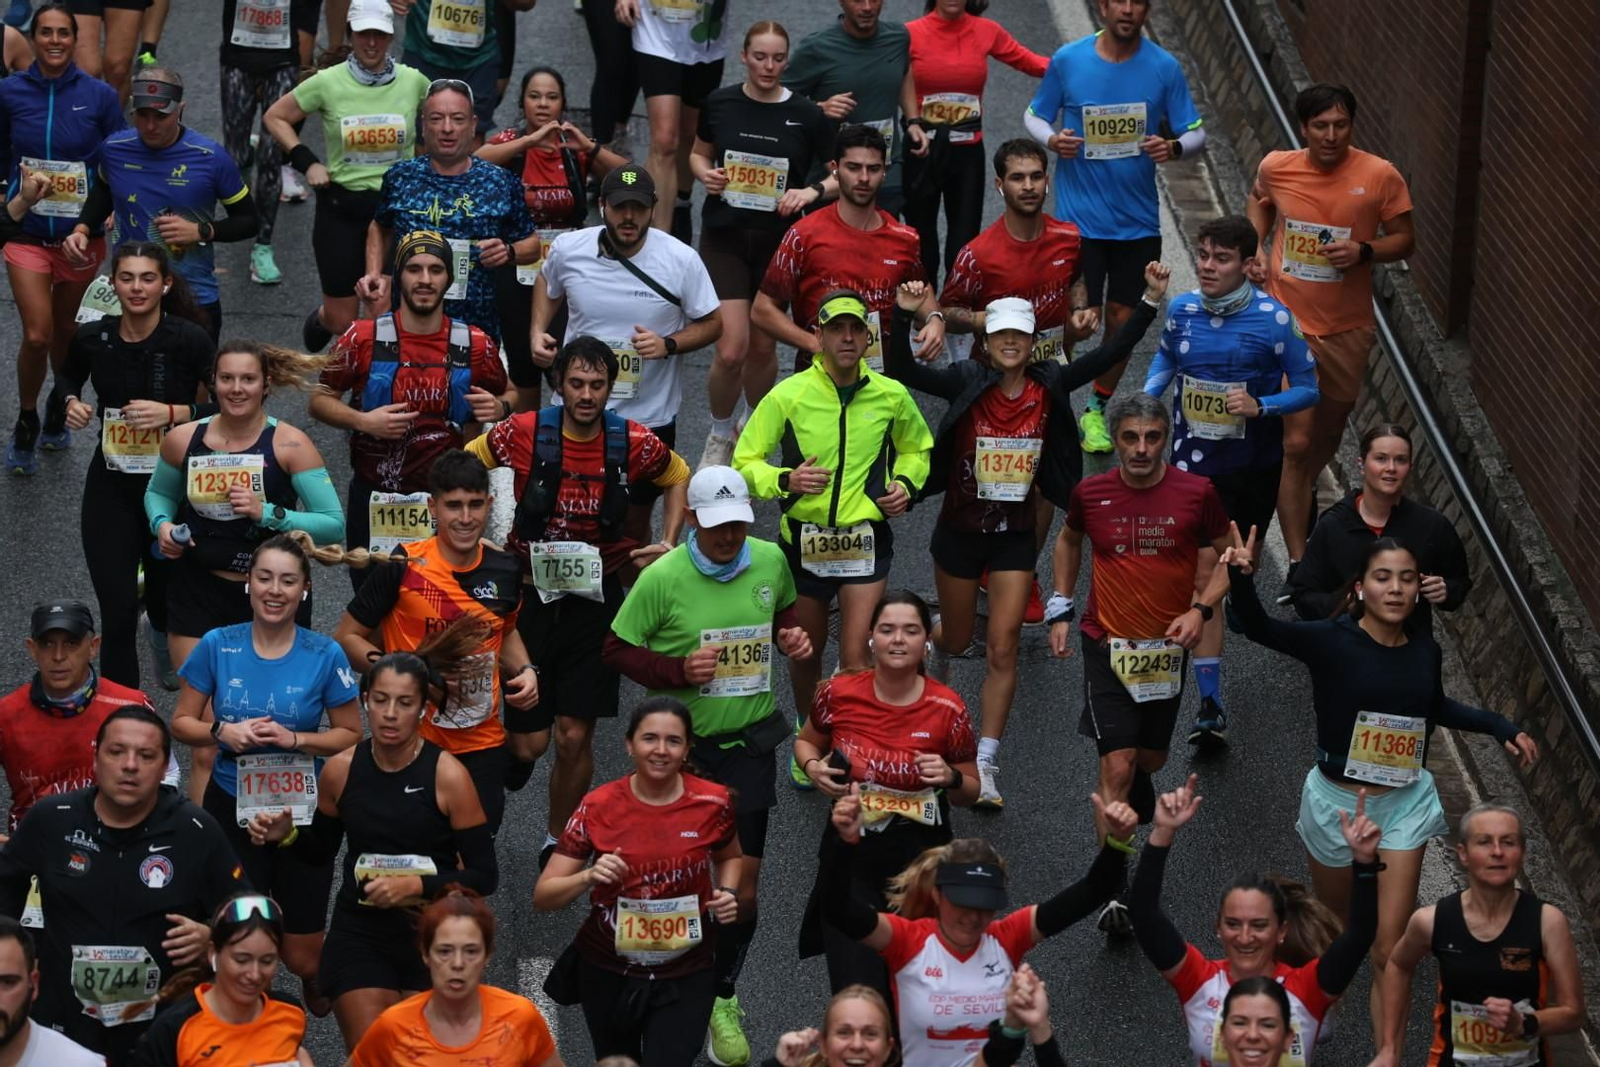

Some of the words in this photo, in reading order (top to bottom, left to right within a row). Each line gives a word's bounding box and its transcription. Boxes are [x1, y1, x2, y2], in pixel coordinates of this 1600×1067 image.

[240, 6, 283, 27] 17868
[436, 4, 479, 26] 10676
[1089, 118, 1137, 135] 10929
[349, 128, 396, 146] 13653
[729, 165, 776, 188] 15031
[109, 425, 160, 444] 12121
[982, 454, 1023, 473] 13745
[195, 472, 251, 493] 12379
[377, 508, 429, 526] 11154
[1138, 526, 1165, 536] media
[808, 534, 863, 554] 13304
[1139, 538, 1175, 547] maratón
[542, 559, 585, 578] 7755
[1117, 655, 1171, 674] 12243
[1361, 730, 1417, 757] 11368
[243, 772, 305, 795] 17638
[862, 795, 923, 814] 13201
[625, 916, 687, 940] 13690
[84, 967, 139, 991] 8744
[934, 1004, 954, 1015] DE
